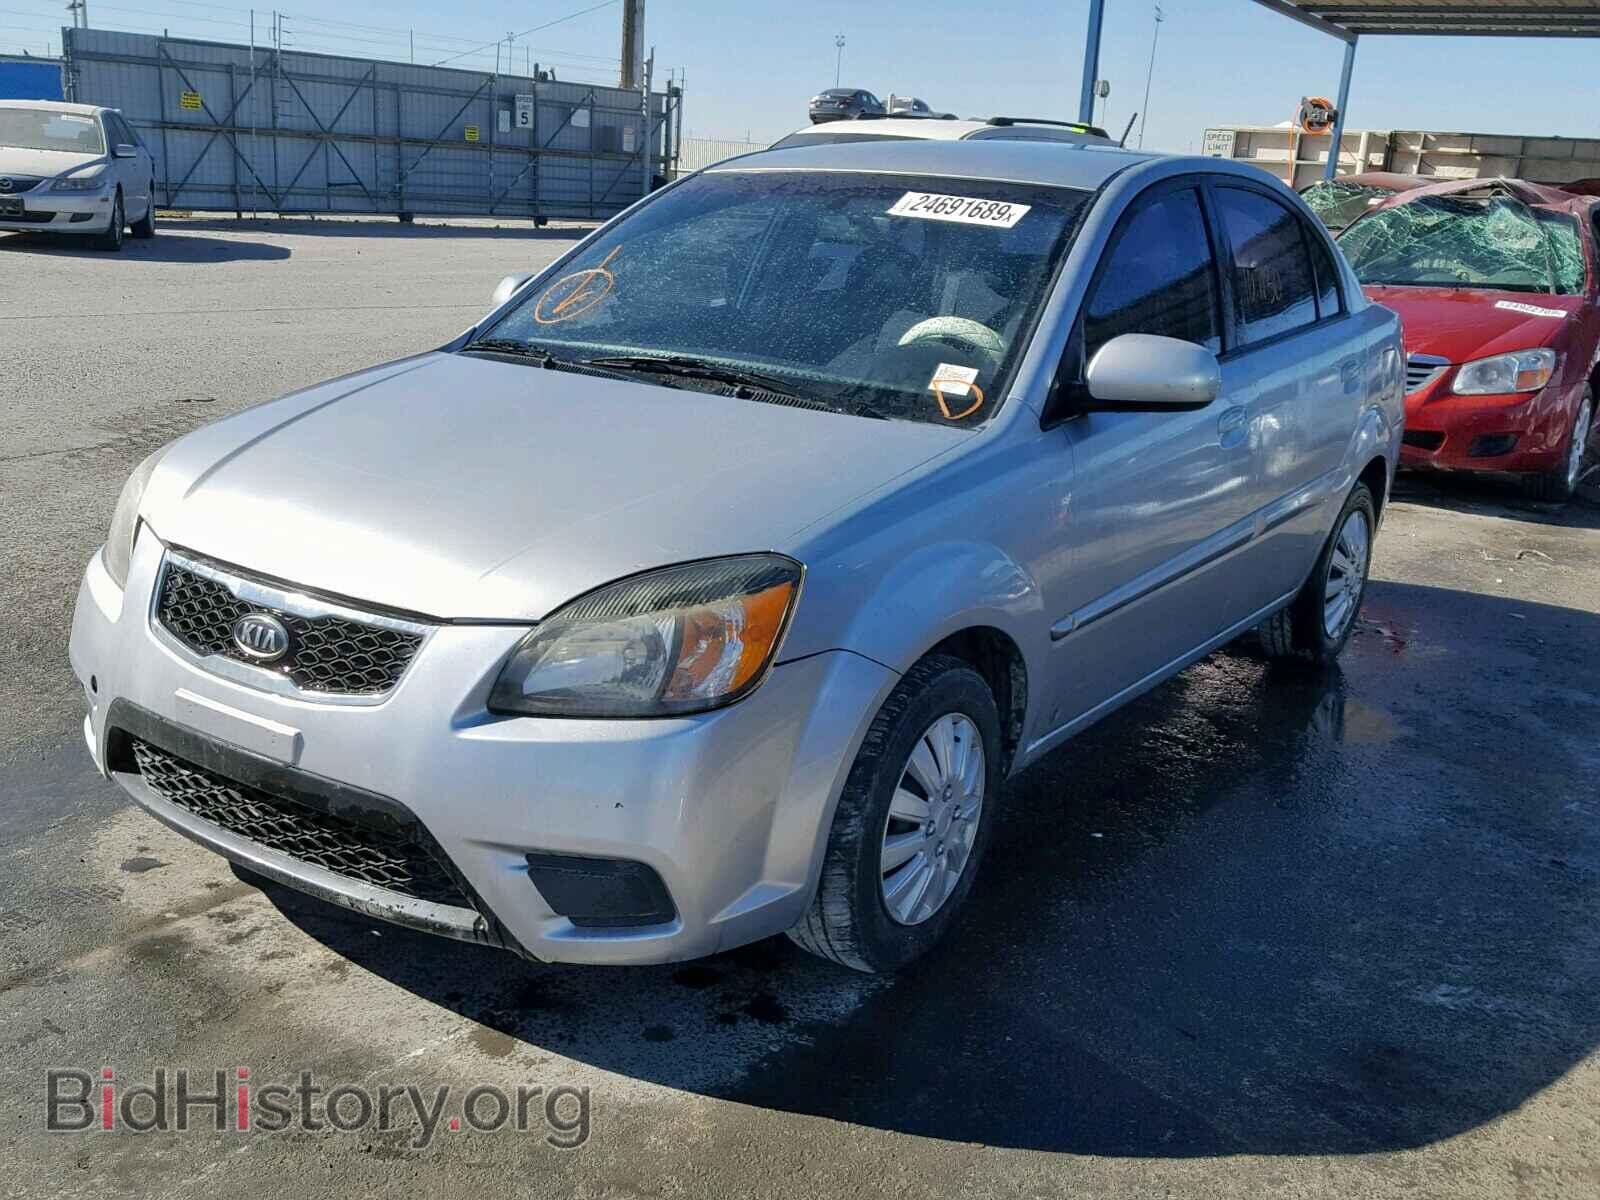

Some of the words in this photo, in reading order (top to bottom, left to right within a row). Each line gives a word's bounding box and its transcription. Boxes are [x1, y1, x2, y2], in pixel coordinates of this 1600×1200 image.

[520, 111, 529, 125] 5
[1206, 133, 1233, 142] SPEED
[1207, 143, 1229, 151] LIMIT
[242, 621, 276, 651] KIA
